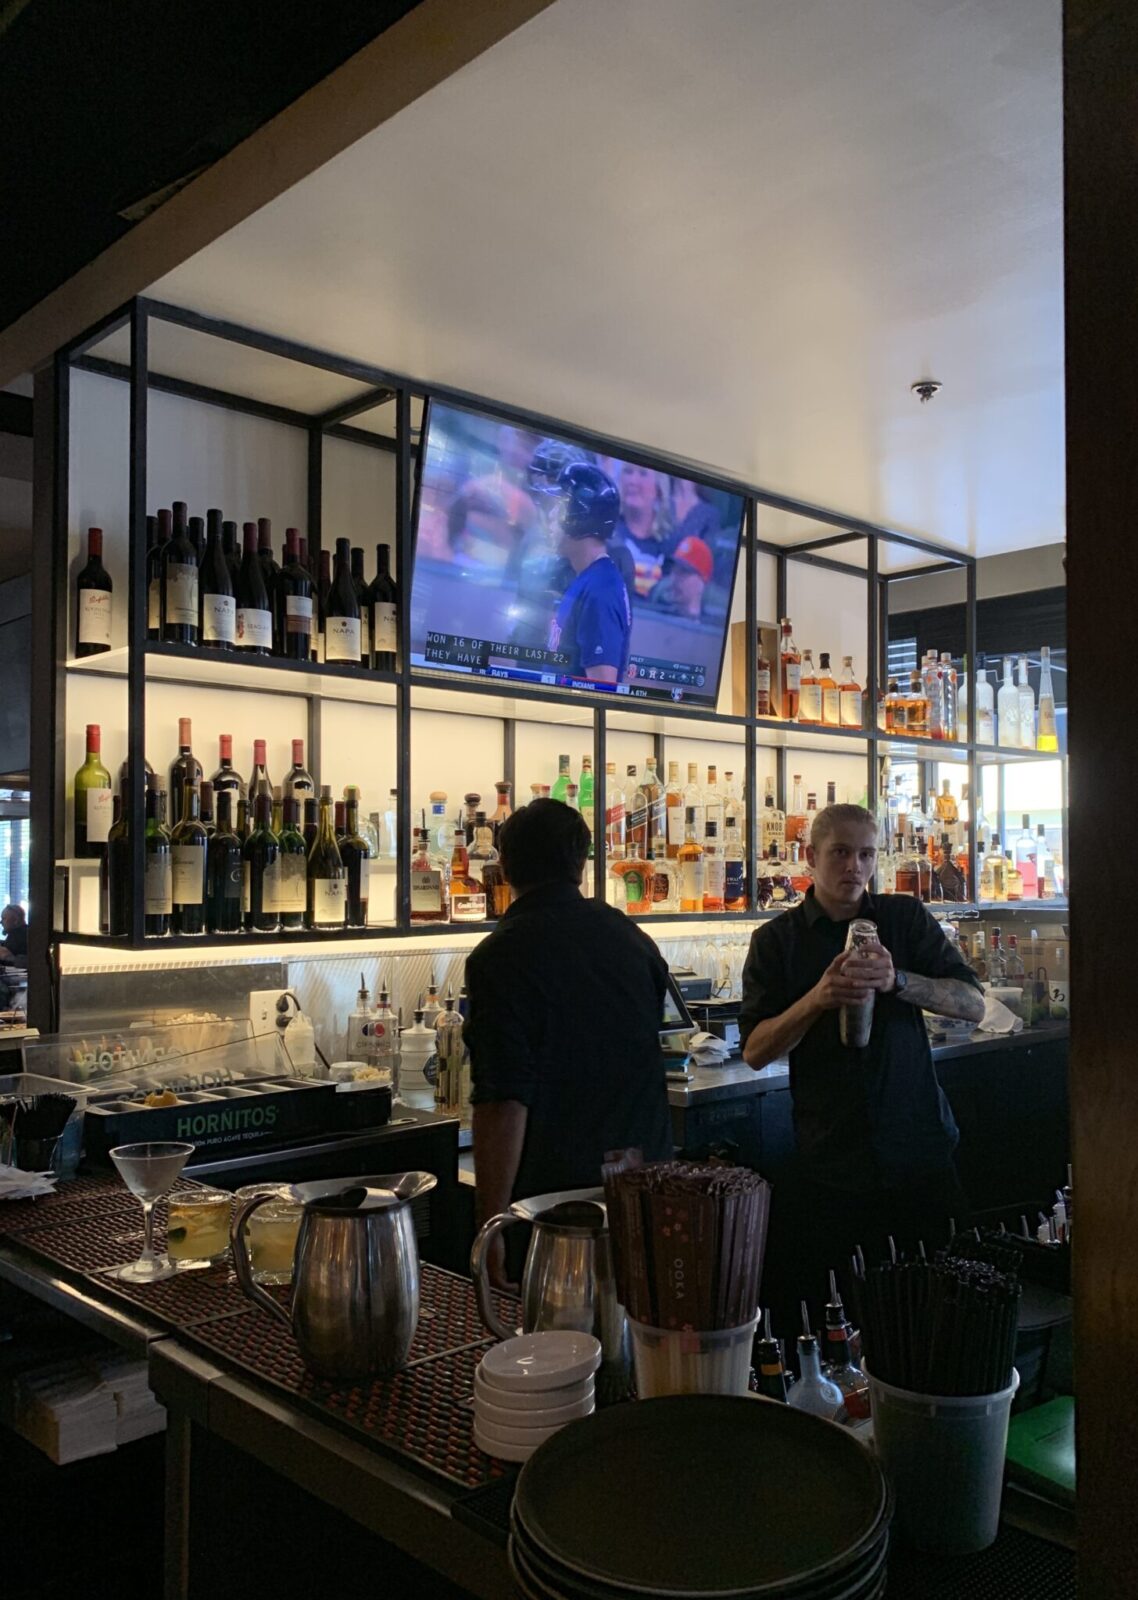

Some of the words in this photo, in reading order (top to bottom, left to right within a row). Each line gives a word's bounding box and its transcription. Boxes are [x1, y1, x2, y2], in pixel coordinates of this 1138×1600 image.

[428, 632, 446, 645] WON
[453, 637, 465, 648] 16
[471, 639, 483, 649] OF
[491, 643, 519, 656] THEIR
[525, 649, 548, 660] LAST
[553, 653, 569, 664] 22.
[426, 648, 451, 660] THEY
[457, 652, 482, 665] HAVE
[659, 671, 665, 680] 2
[766, 821, 783, 832] KNOB
